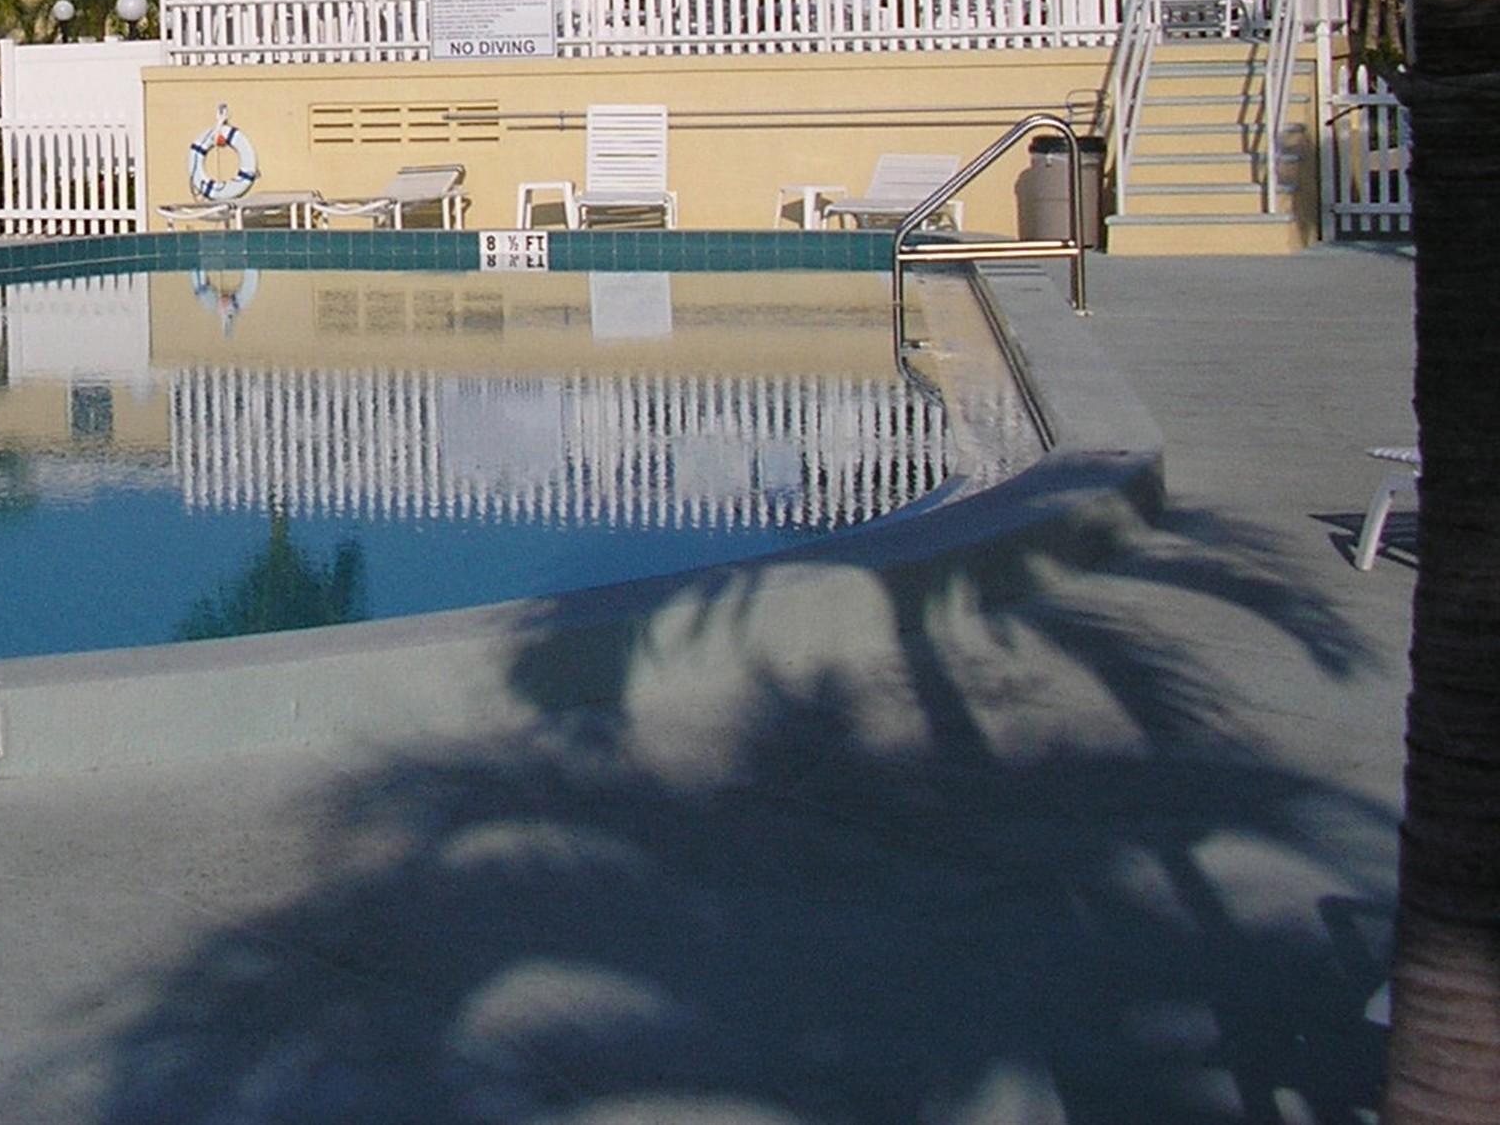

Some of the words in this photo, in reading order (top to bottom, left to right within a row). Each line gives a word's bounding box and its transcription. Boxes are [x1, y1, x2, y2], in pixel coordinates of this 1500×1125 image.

[450, 41, 474, 55] NO
[479, 39, 536, 55] DIVING
[486, 235, 496, 251] 8
